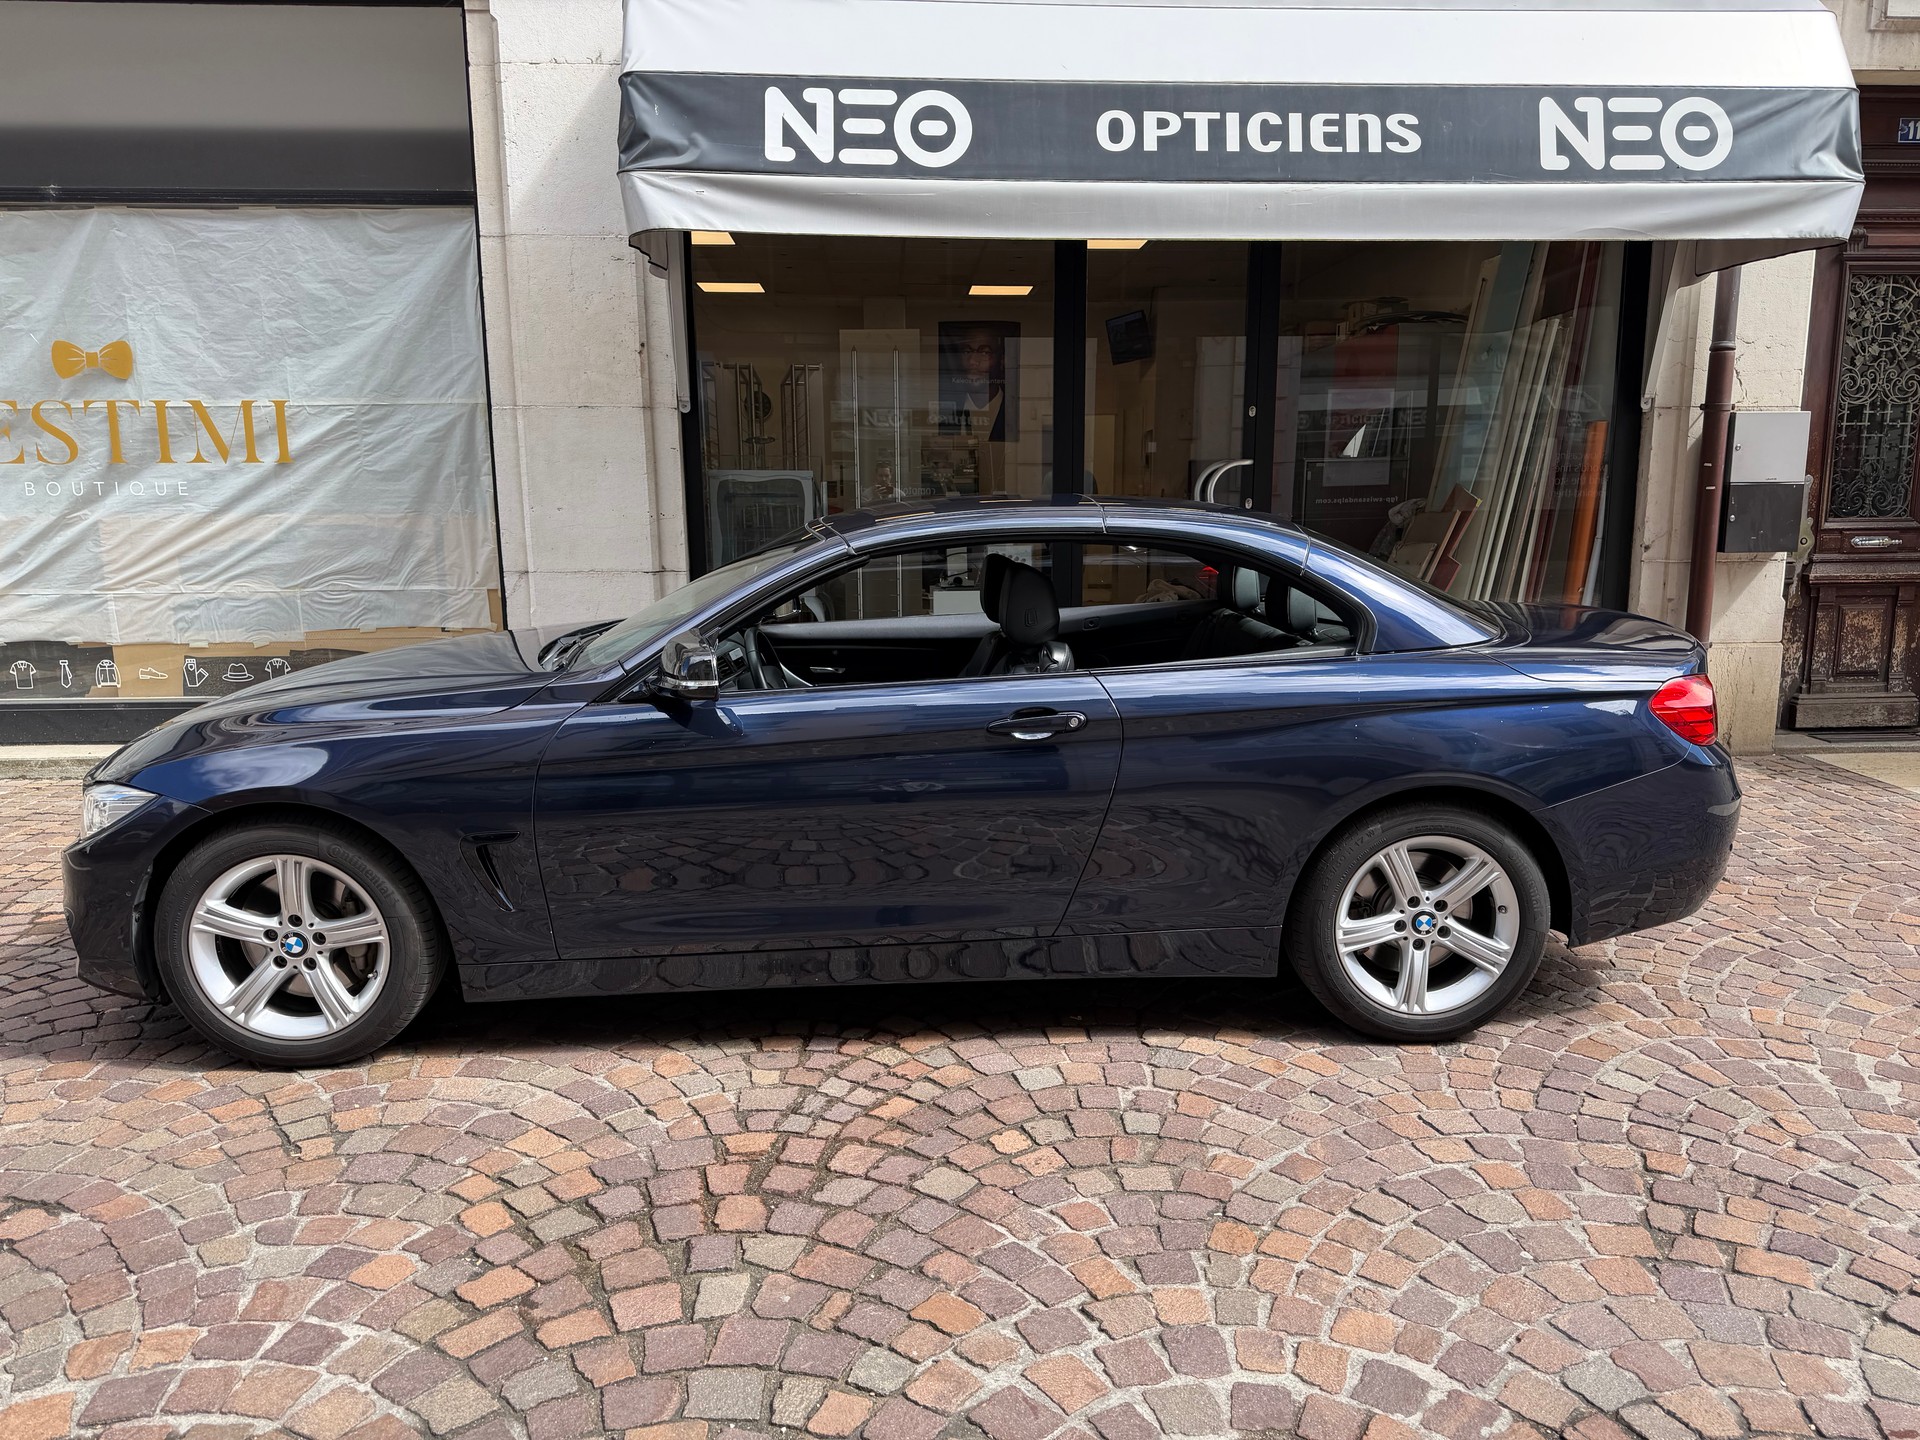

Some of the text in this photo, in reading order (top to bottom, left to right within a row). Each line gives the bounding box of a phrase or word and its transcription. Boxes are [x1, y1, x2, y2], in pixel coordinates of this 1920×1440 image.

[764, 86, 973, 168] NEO
[1539, 96, 1734, 171] NEO
[24, 481, 189, 497] BOUTIQUE
[326, 843, 396, 900] Continental
